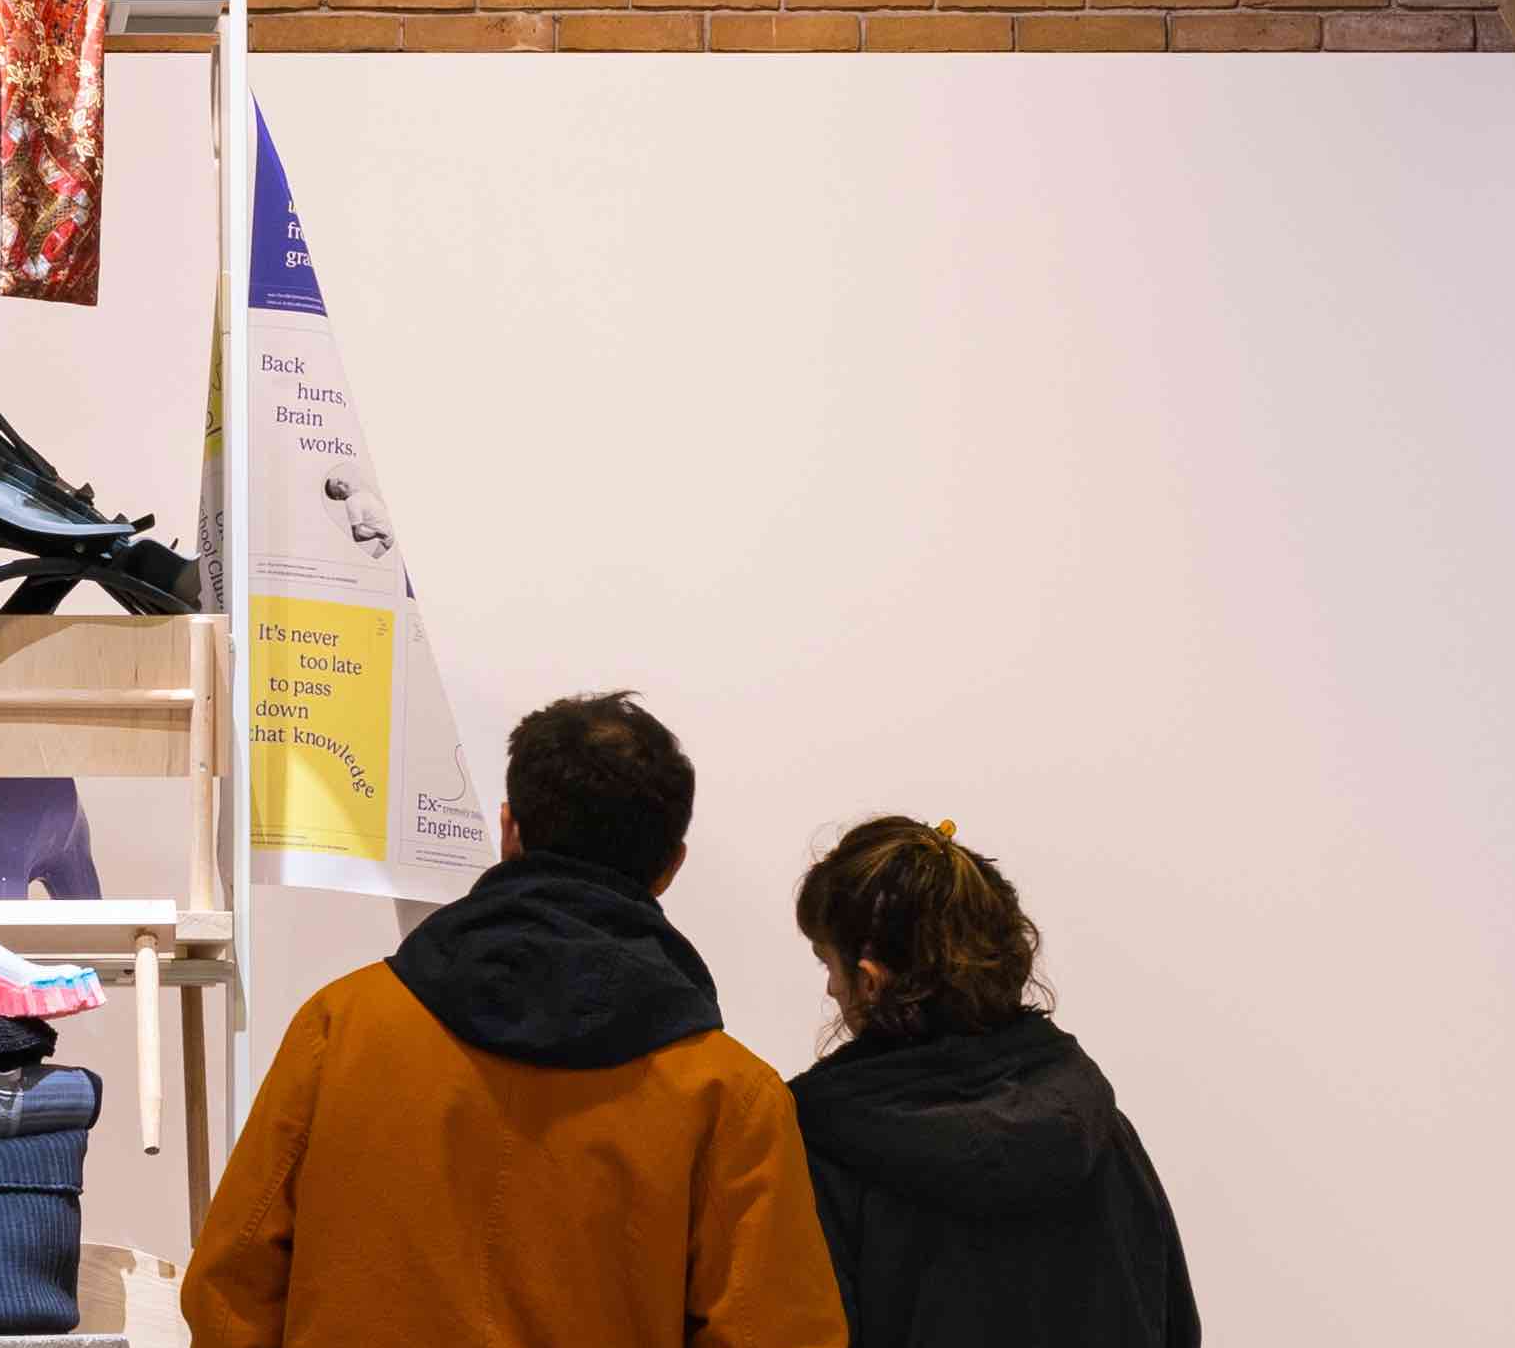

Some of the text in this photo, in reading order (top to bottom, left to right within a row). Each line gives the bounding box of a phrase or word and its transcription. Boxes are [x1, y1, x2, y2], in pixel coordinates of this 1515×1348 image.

[261, 354, 305, 375] Back
[296, 382, 347, 408] hurts,
[276, 405, 323, 427] Brain
[299, 437, 357, 458] works.
[290, 629, 339, 647] never
[300, 653, 363, 676] too late
[270, 677, 332, 697] to pass
[255, 700, 309, 719] down
[293, 726, 375, 799] knowledge
[416, 815, 484, 842] Engineer
